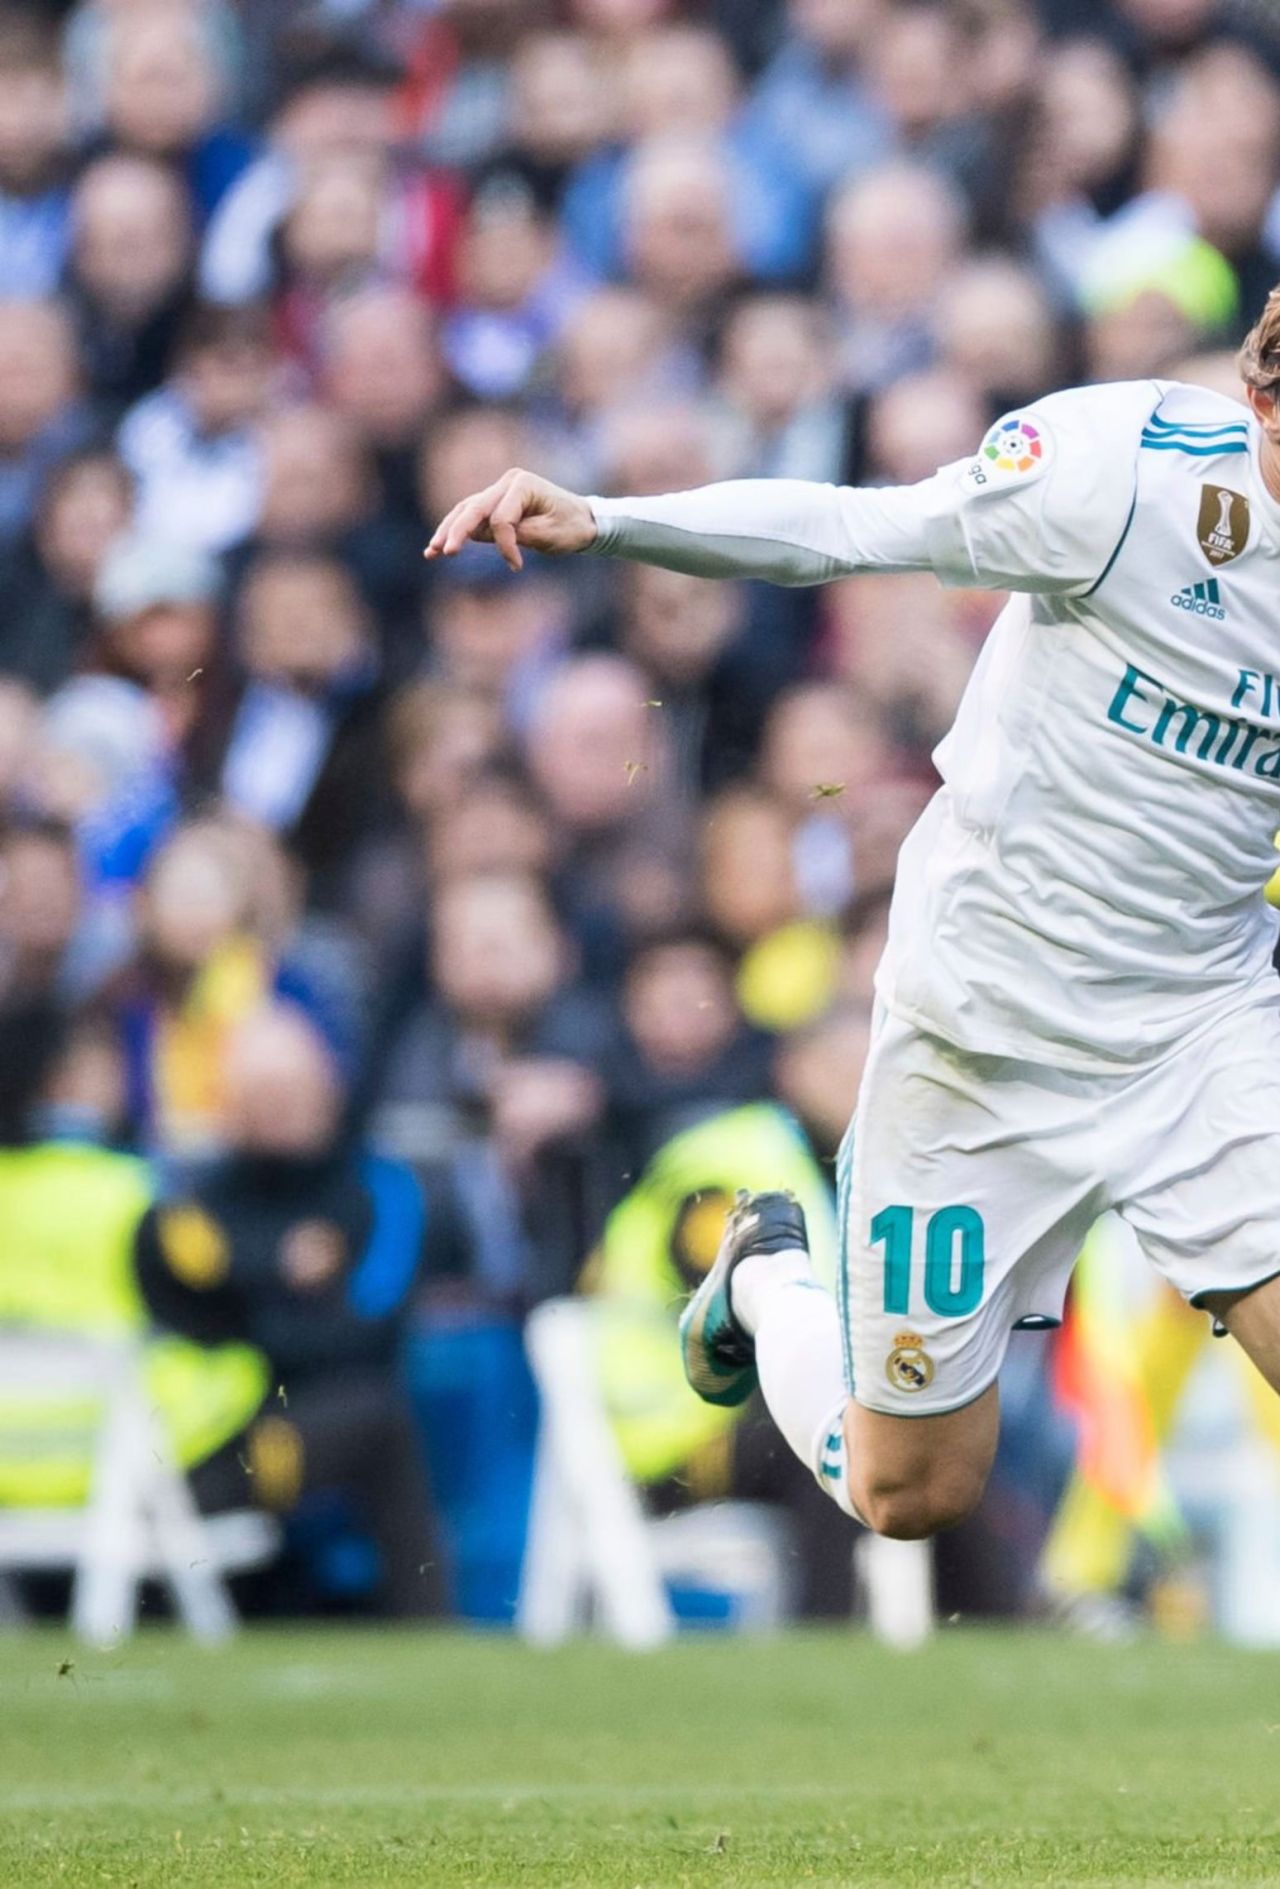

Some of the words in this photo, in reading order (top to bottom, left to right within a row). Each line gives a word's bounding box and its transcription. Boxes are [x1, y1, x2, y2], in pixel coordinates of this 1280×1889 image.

[1207, 533, 1235, 551] FIFA
[1170, 594, 1226, 621] adidas
[869, 1205, 985, 1318] 10
